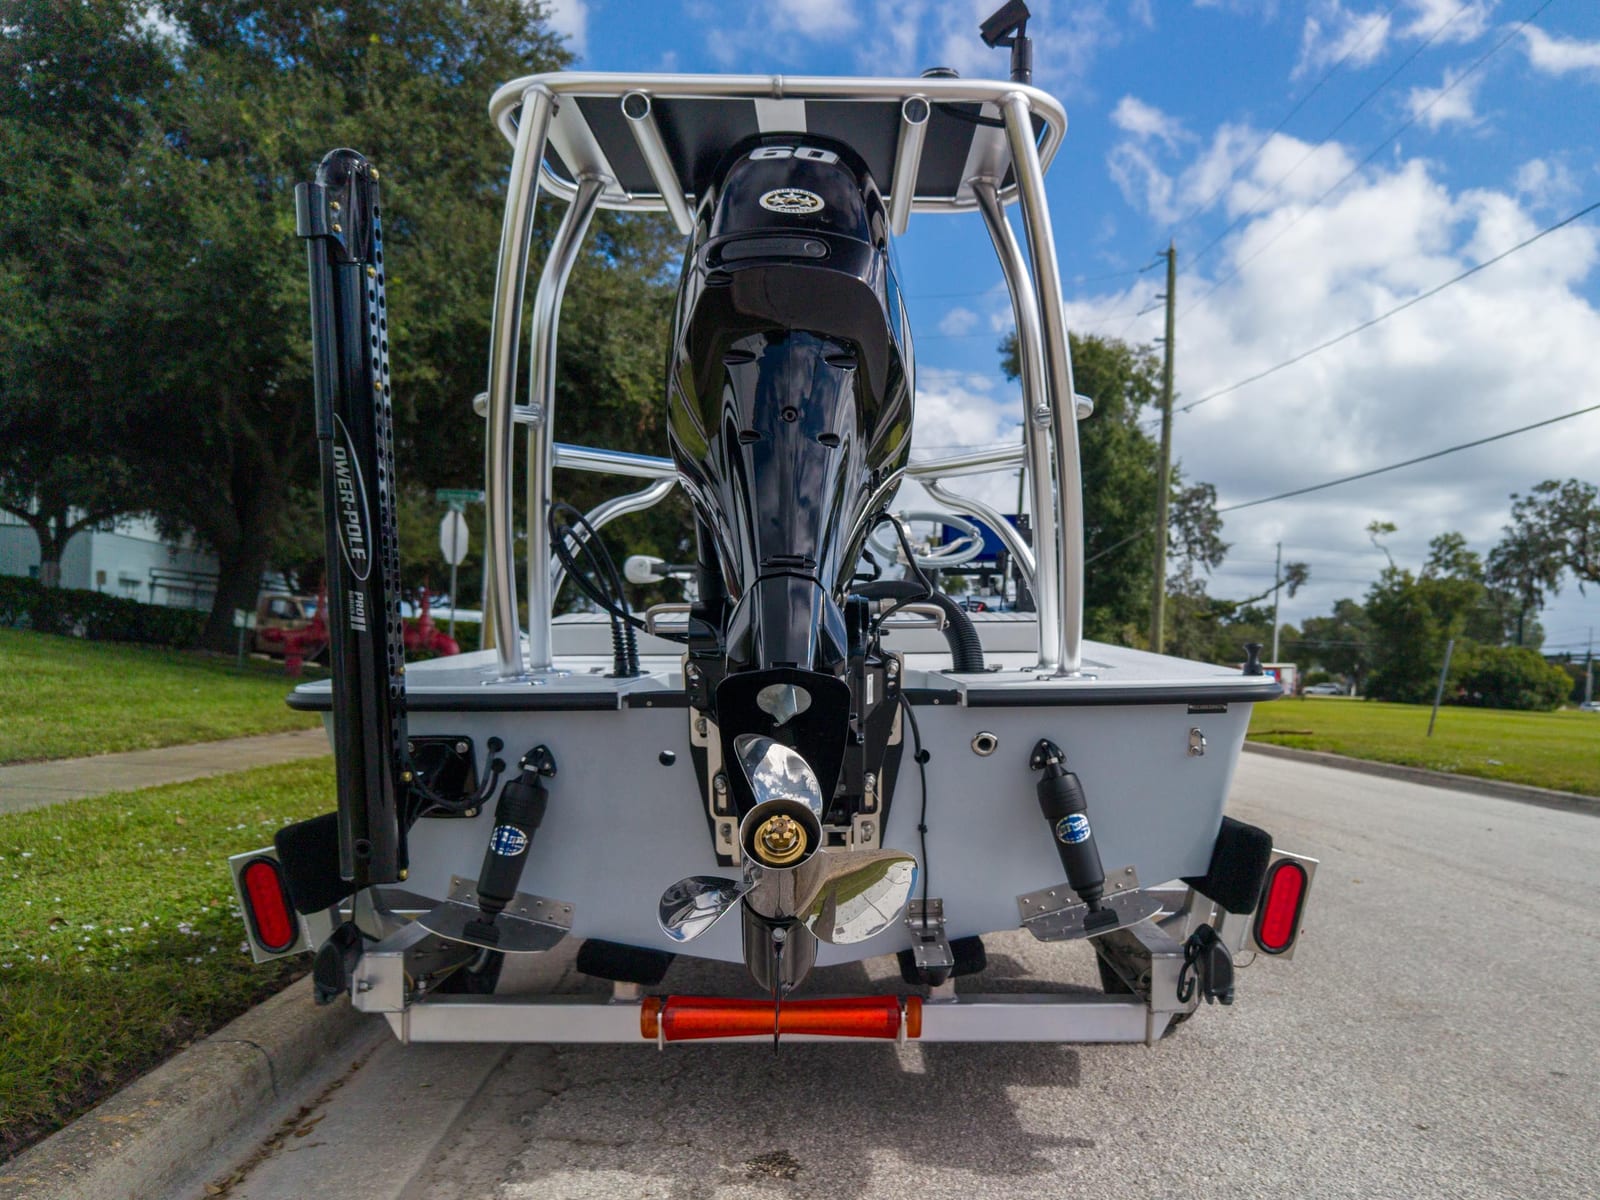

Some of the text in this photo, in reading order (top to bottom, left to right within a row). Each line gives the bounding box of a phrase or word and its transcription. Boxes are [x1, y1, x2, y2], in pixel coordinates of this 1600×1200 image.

[749, 147, 839, 165] 60
[334, 447, 366, 560] OWER-POLE
[354, 592, 365, 616] PRO
